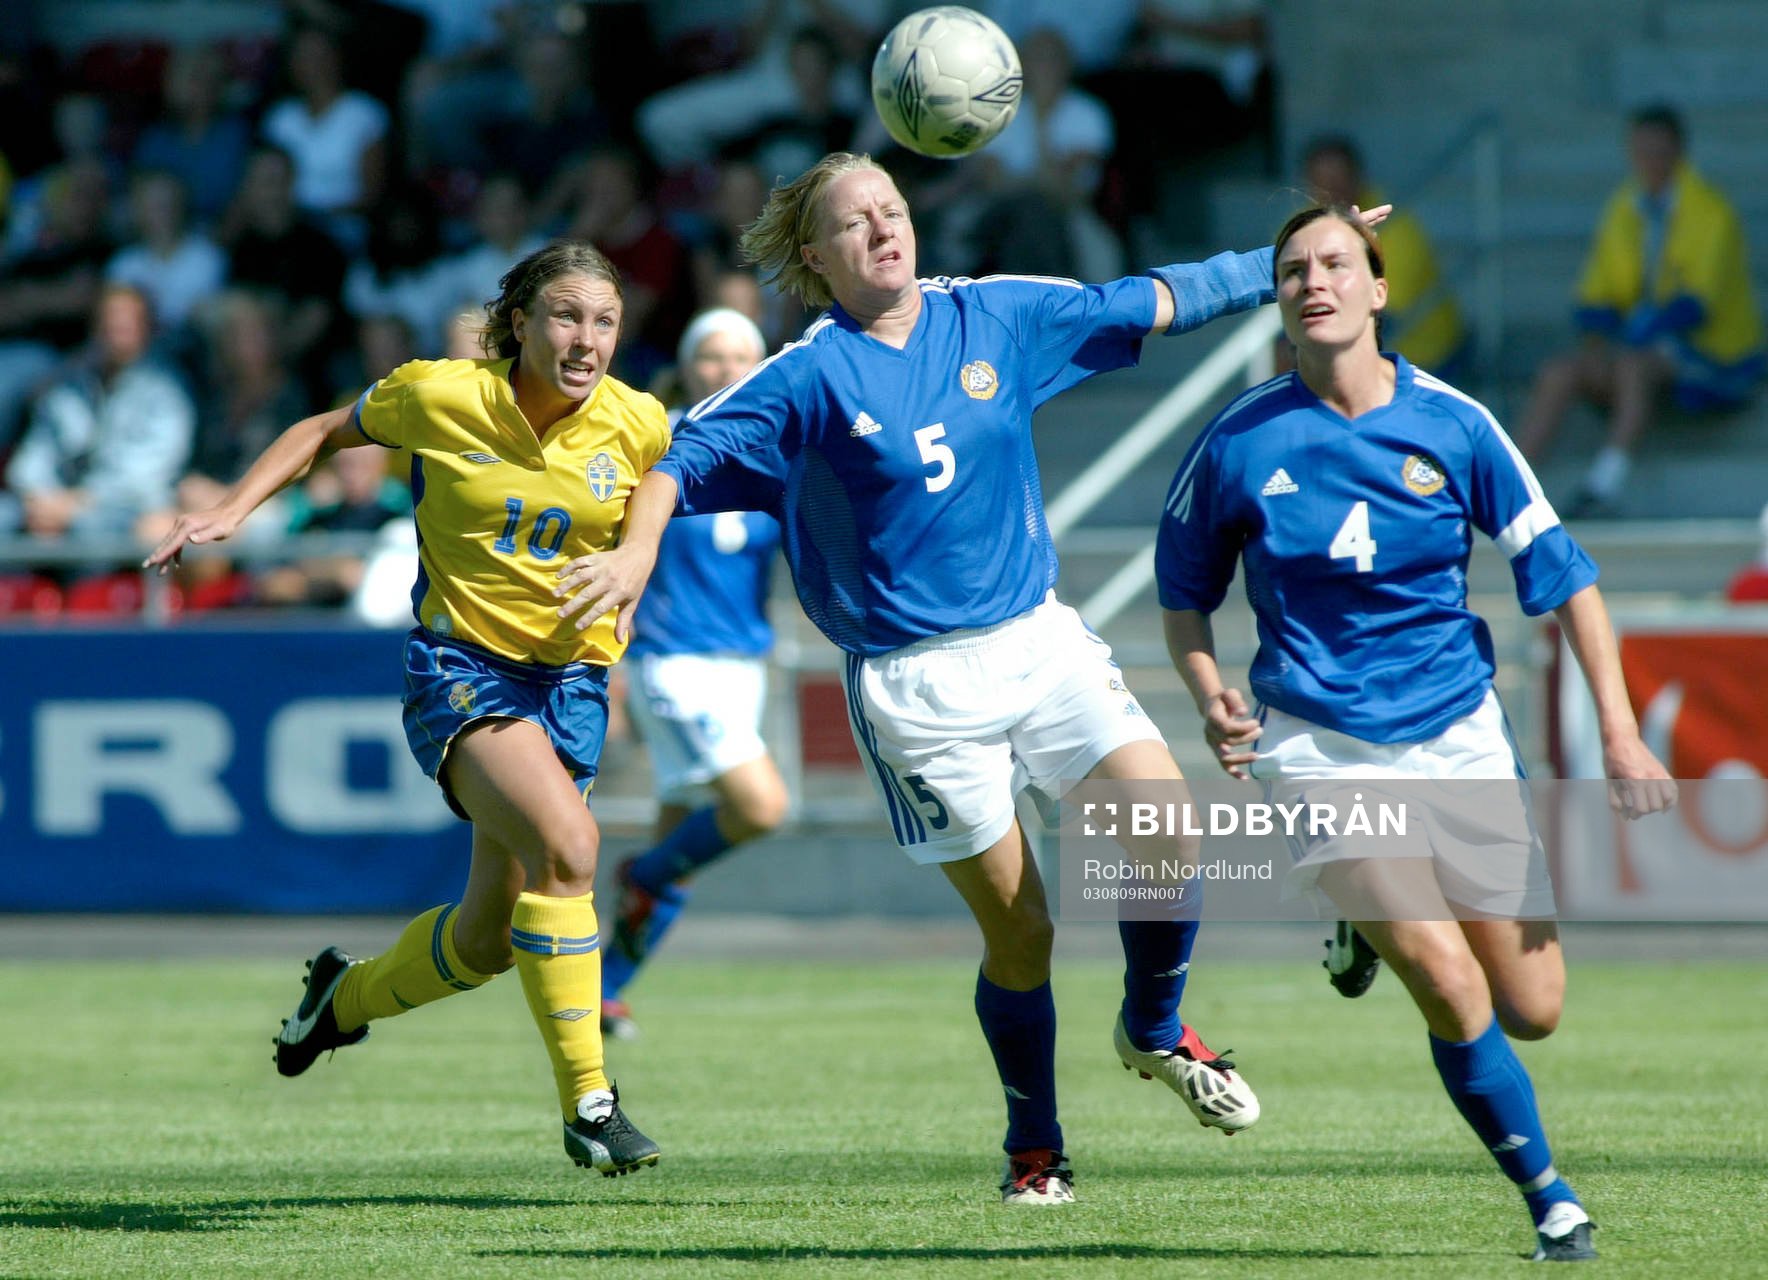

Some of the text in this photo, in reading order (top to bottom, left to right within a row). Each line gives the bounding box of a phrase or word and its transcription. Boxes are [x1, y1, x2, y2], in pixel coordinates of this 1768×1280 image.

[914, 422, 956, 493] 5
[493, 496, 573, 561] 10
[1329, 500, 1378, 573] 4
[0, 697, 462, 836] RO
[903, 774, 949, 830] 5
